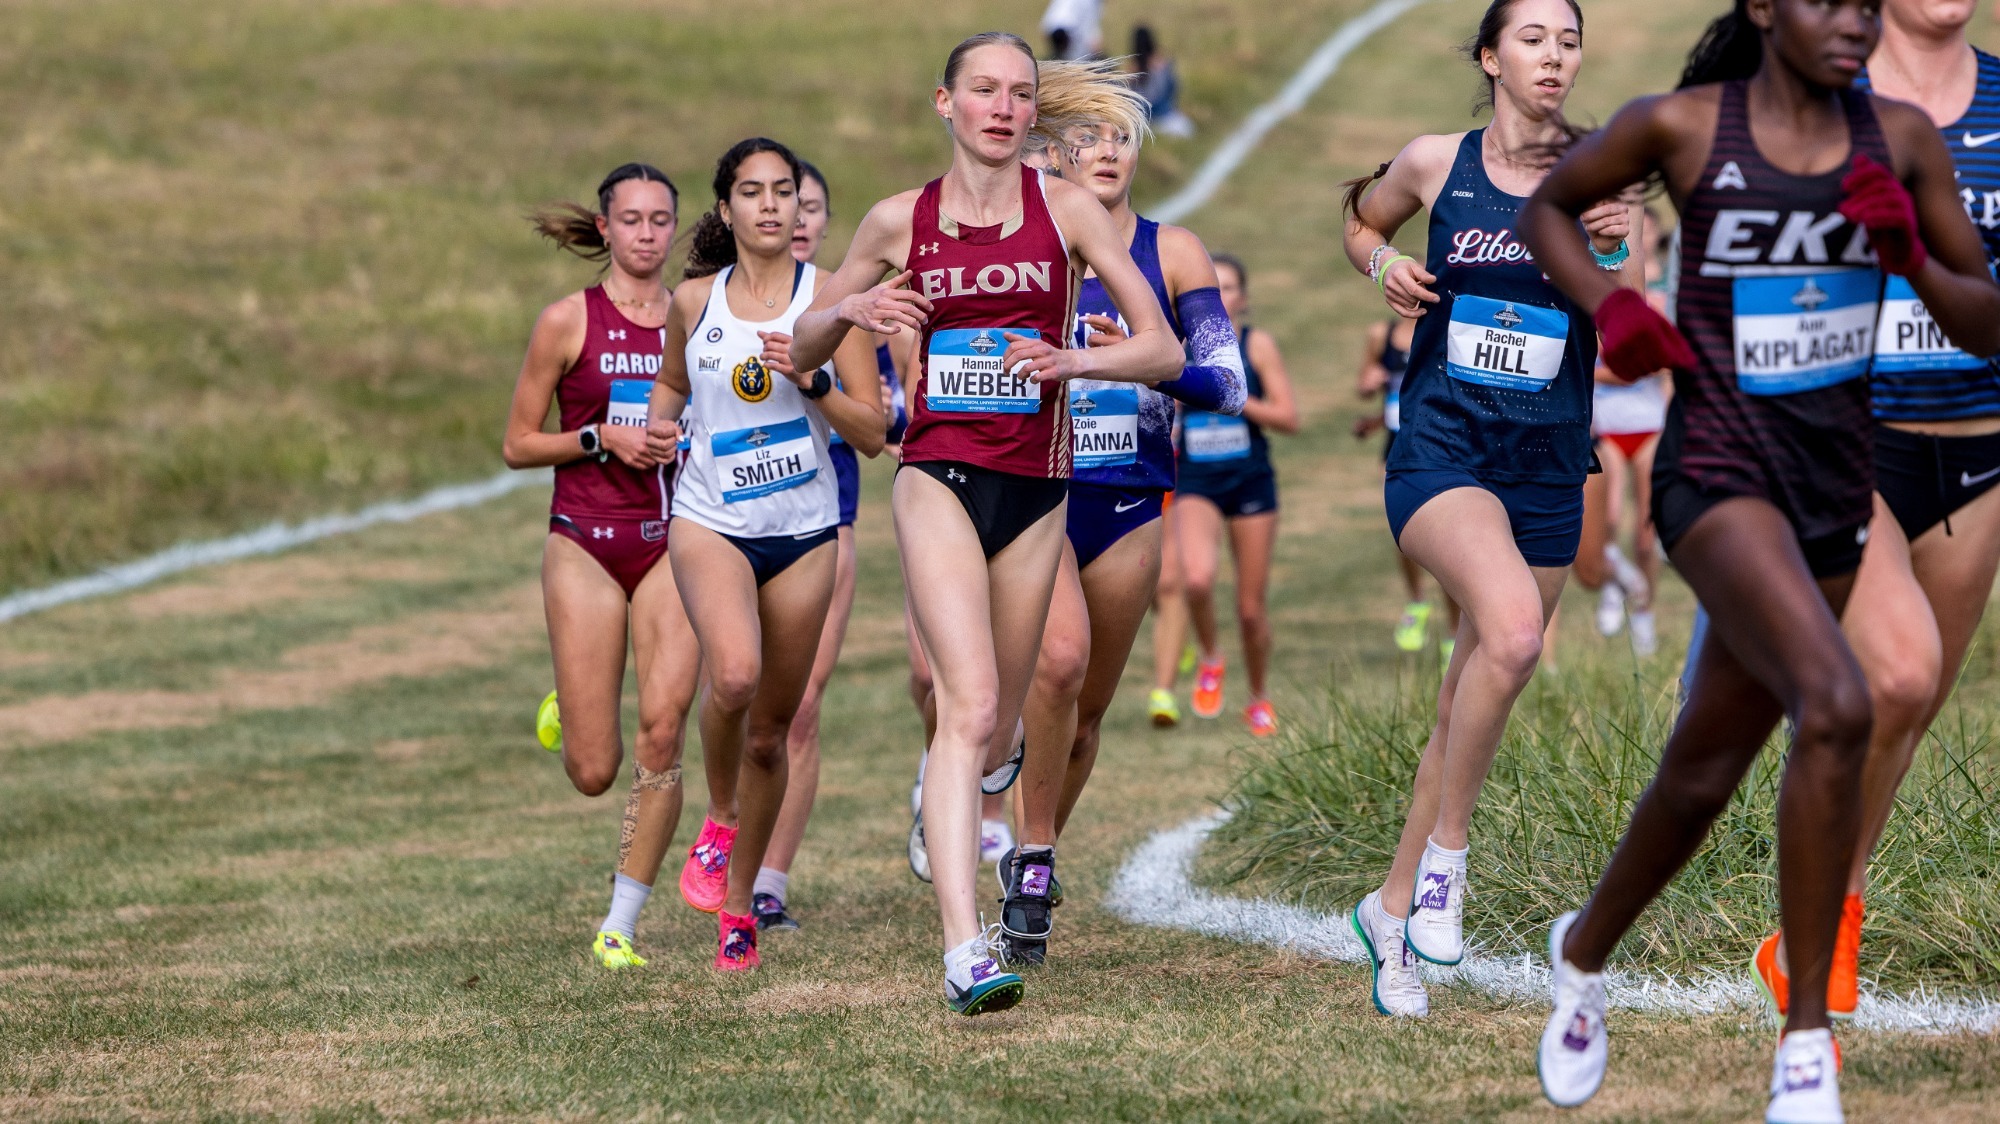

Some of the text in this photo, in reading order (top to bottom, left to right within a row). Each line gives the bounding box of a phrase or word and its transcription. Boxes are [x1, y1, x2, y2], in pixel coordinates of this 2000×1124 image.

[919, 261, 1052, 301] ELON
[1485, 329, 1527, 347] Rachel
[1743, 327, 1868, 367] KIPLAGAT
[600, 351, 663, 375] CARO
[1473, 342, 1529, 375] HILL
[939, 371, 1028, 398] WEBER
[1074, 418, 1097, 430] Zoie
[755, 449, 771, 460] Liz
[732, 453, 802, 488] SMITH
[1024, 886, 1044, 894] LYNX
[1423, 898, 1442, 908] LYNX
